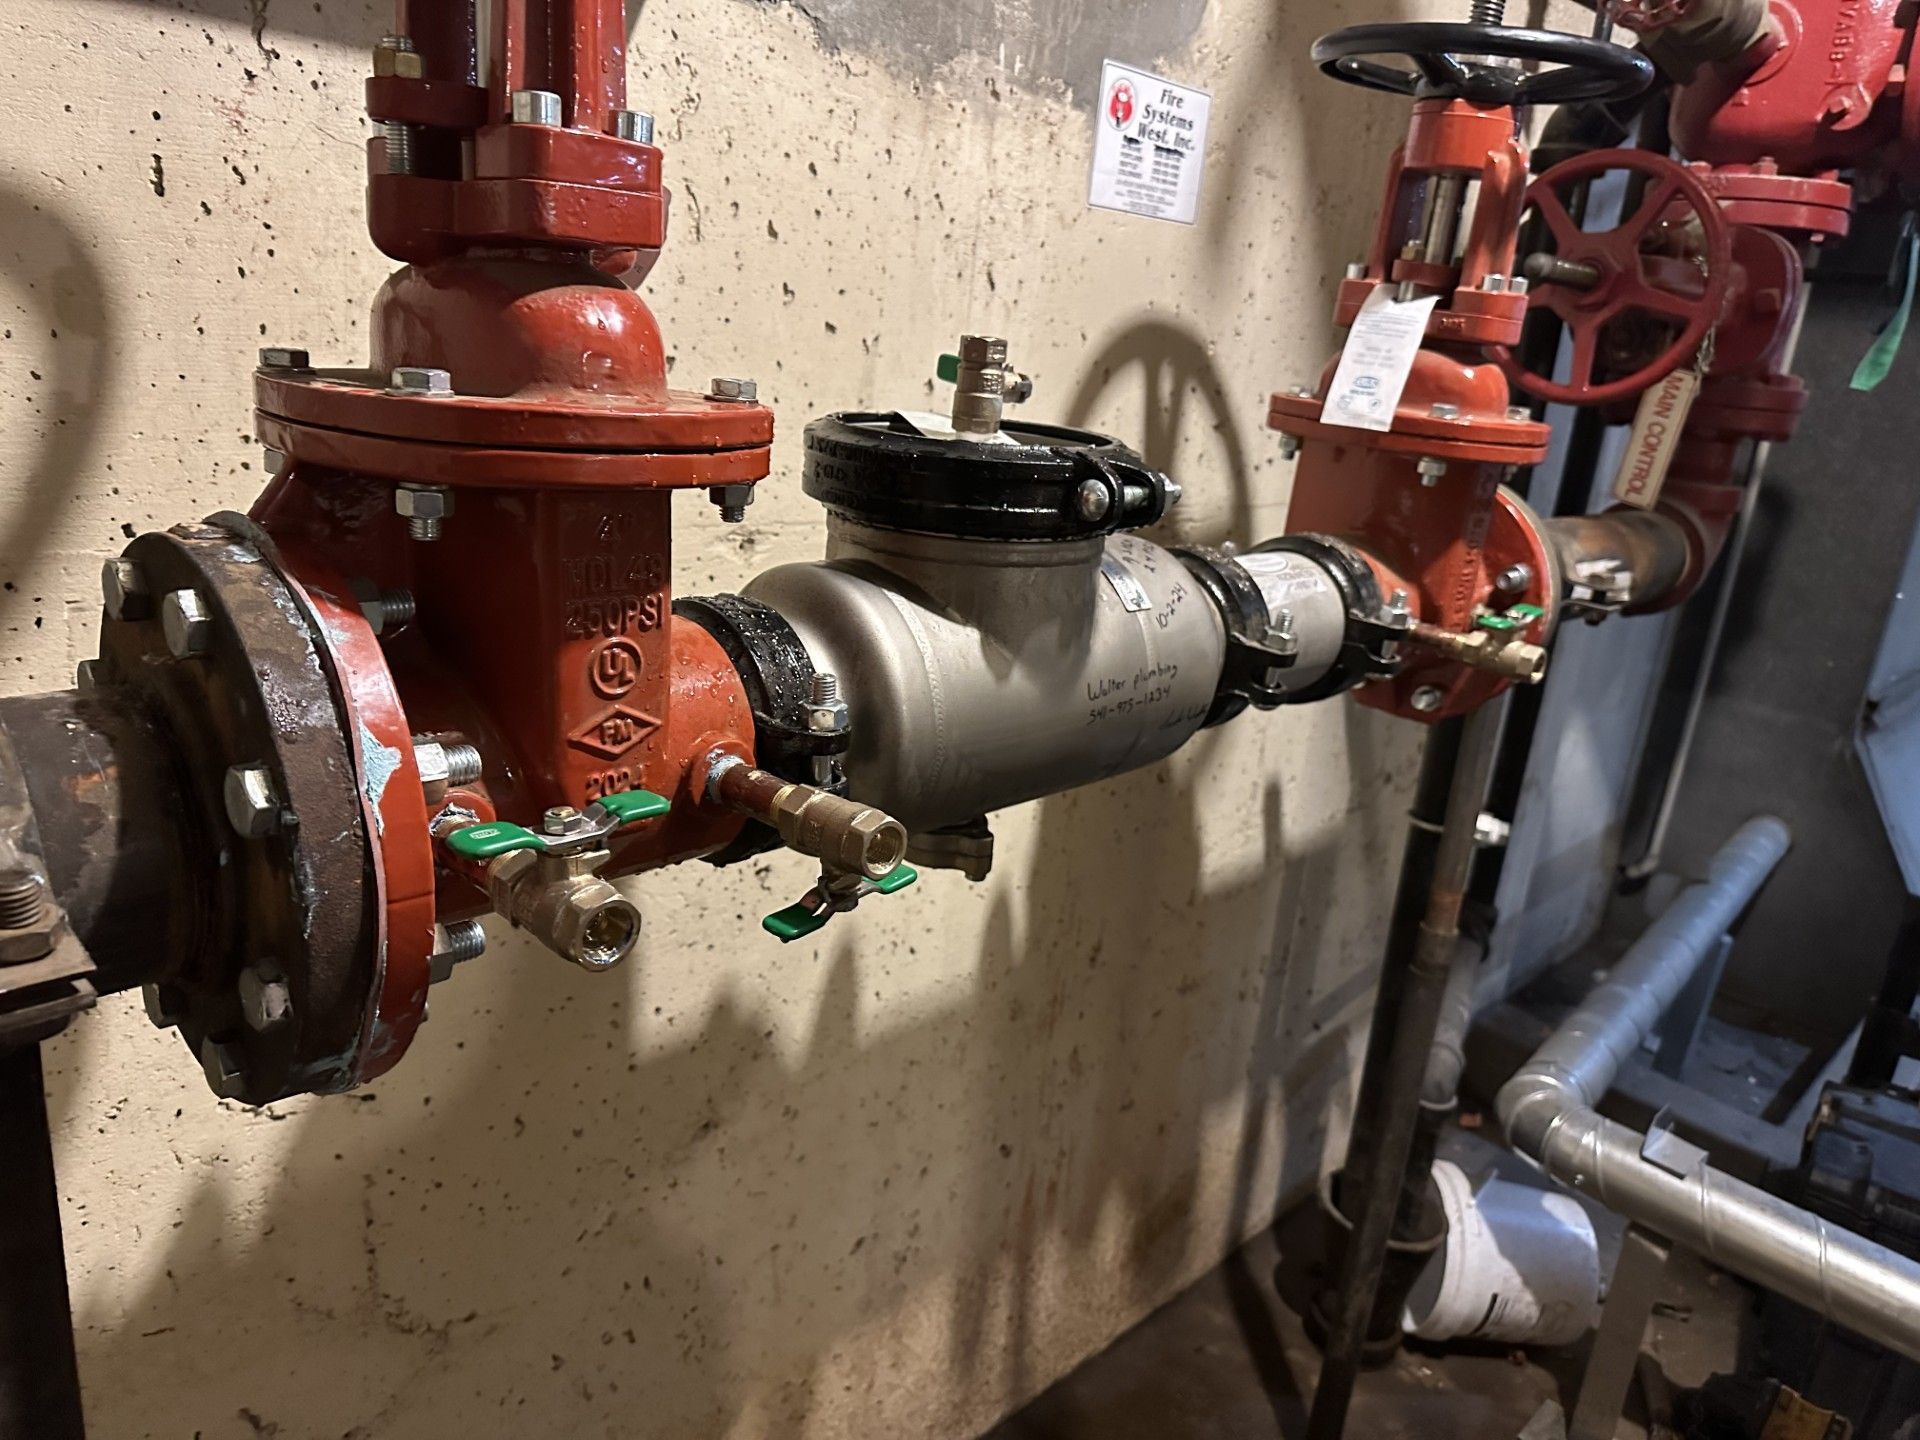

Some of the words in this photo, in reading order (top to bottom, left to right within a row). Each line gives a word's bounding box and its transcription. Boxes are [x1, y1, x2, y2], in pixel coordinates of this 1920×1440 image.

[1142, 104, 1194, 131] Systems
[1160, 88, 1184, 109] Fire
[1173, 132, 1196, 151] Inc.
[1653, 376, 1684, 420] MAIN
[1624, 421, 1666, 498] CONTROL
[565, 592, 664, 641] 250PSI
[1155, 582, 1188, 630] 10-2-24
[1087, 679, 1126, 701] Walter
[1133, 662, 1178, 691] plumbing
[1086, 685, 1172, 726] 541-975-1234
[601, 717, 634, 747] FM
